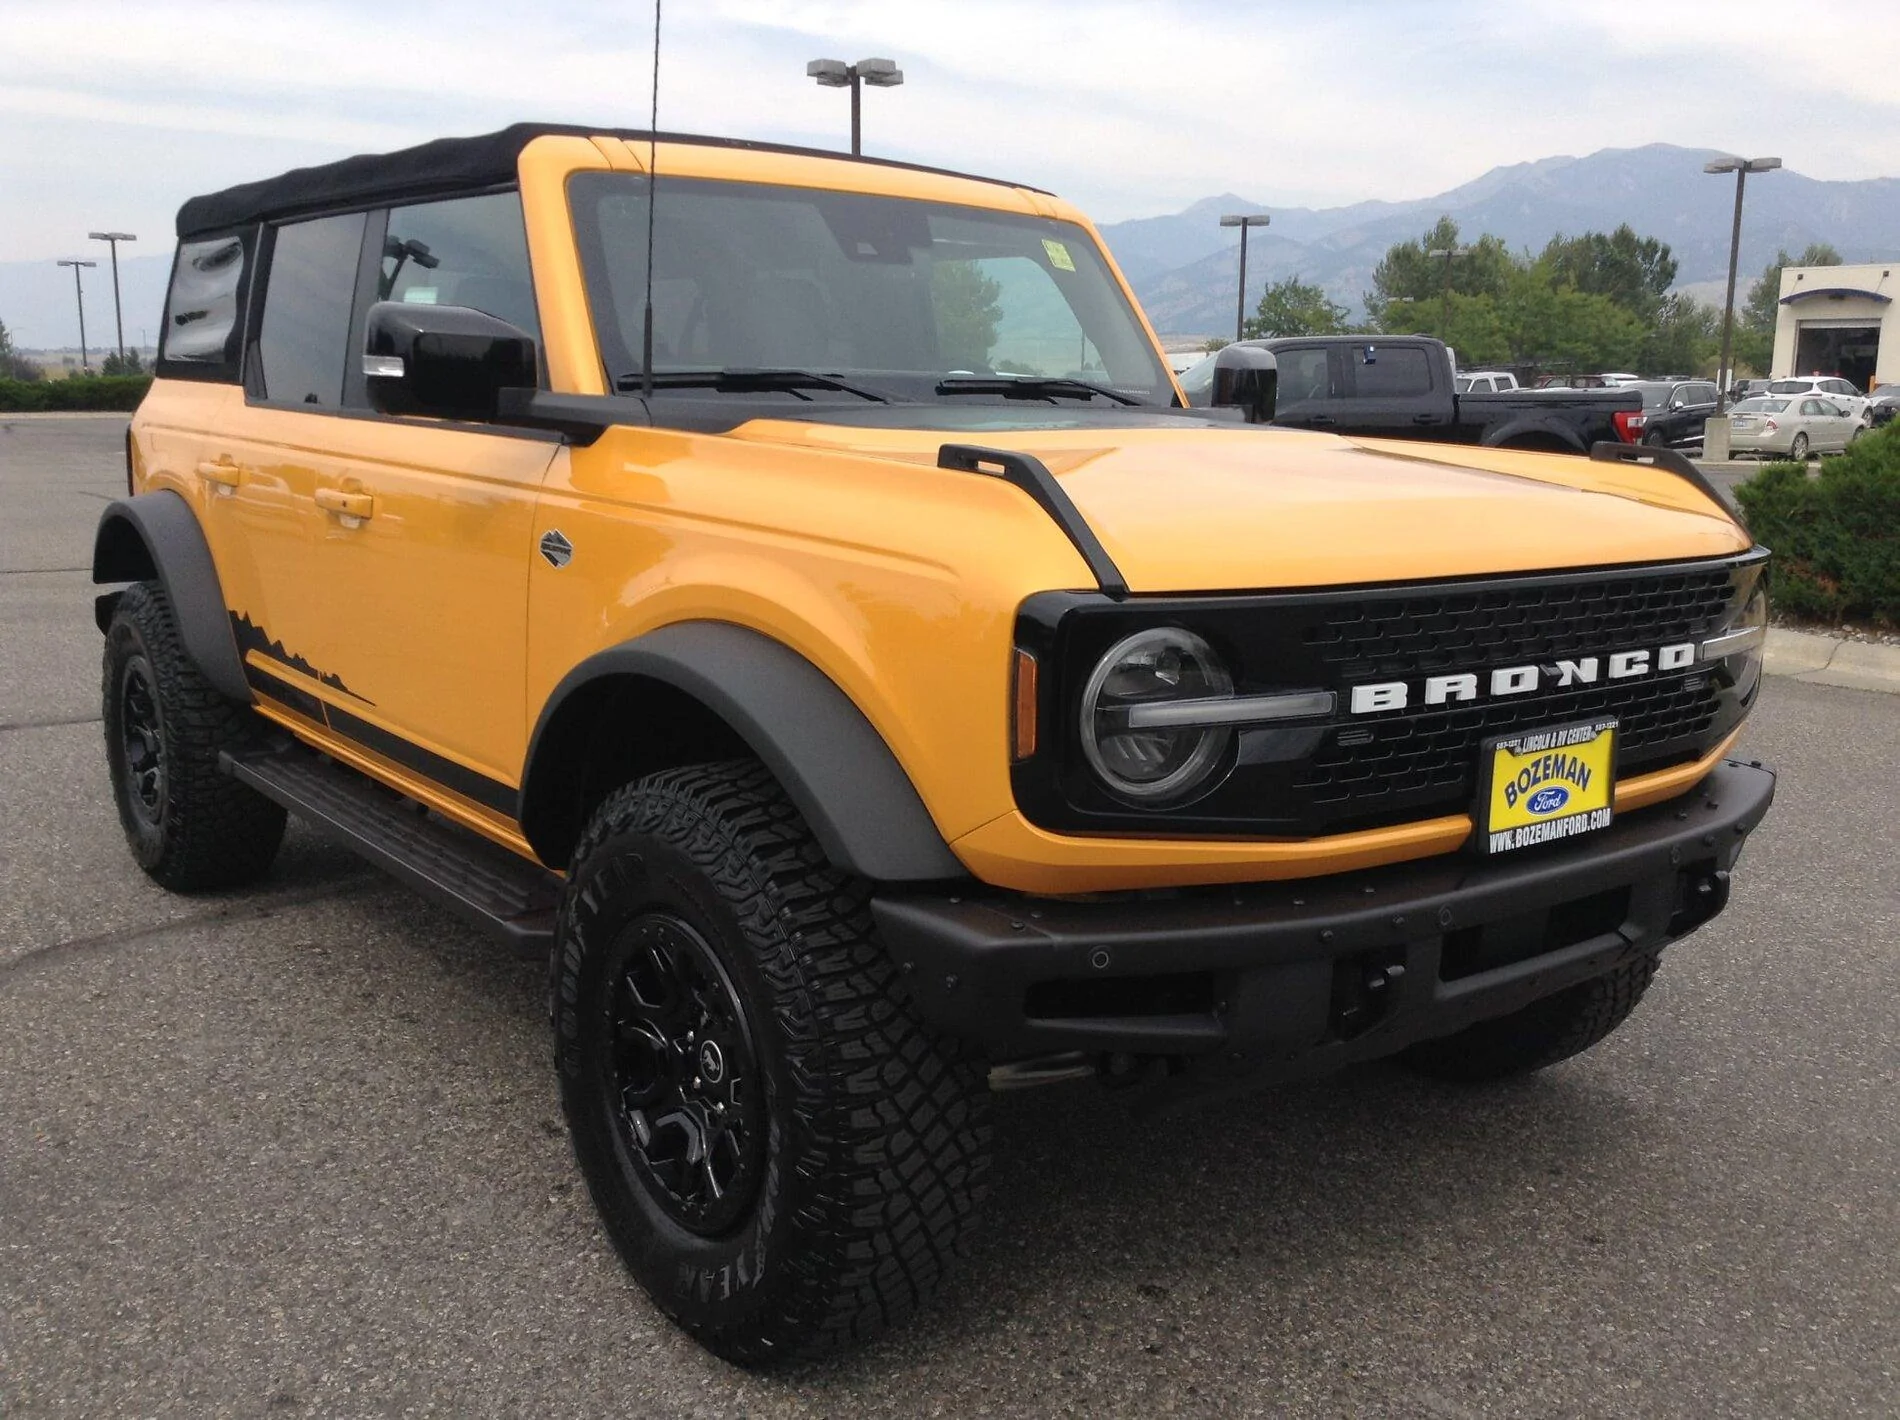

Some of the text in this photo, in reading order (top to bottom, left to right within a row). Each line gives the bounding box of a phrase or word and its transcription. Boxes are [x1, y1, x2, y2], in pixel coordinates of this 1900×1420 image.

[1351, 643, 1695, 714] BRONCO
[1523, 734, 1551, 753] LINCOLN
[1556, 729, 1568, 747] RV
[1566, 725, 1592, 745] CENTER
[1504, 753, 1592, 809] BOZEMAN
[1534, 791, 1562, 812] Ford
[1489, 808, 1612, 854] WWW.BOZEMANFORD.COM
